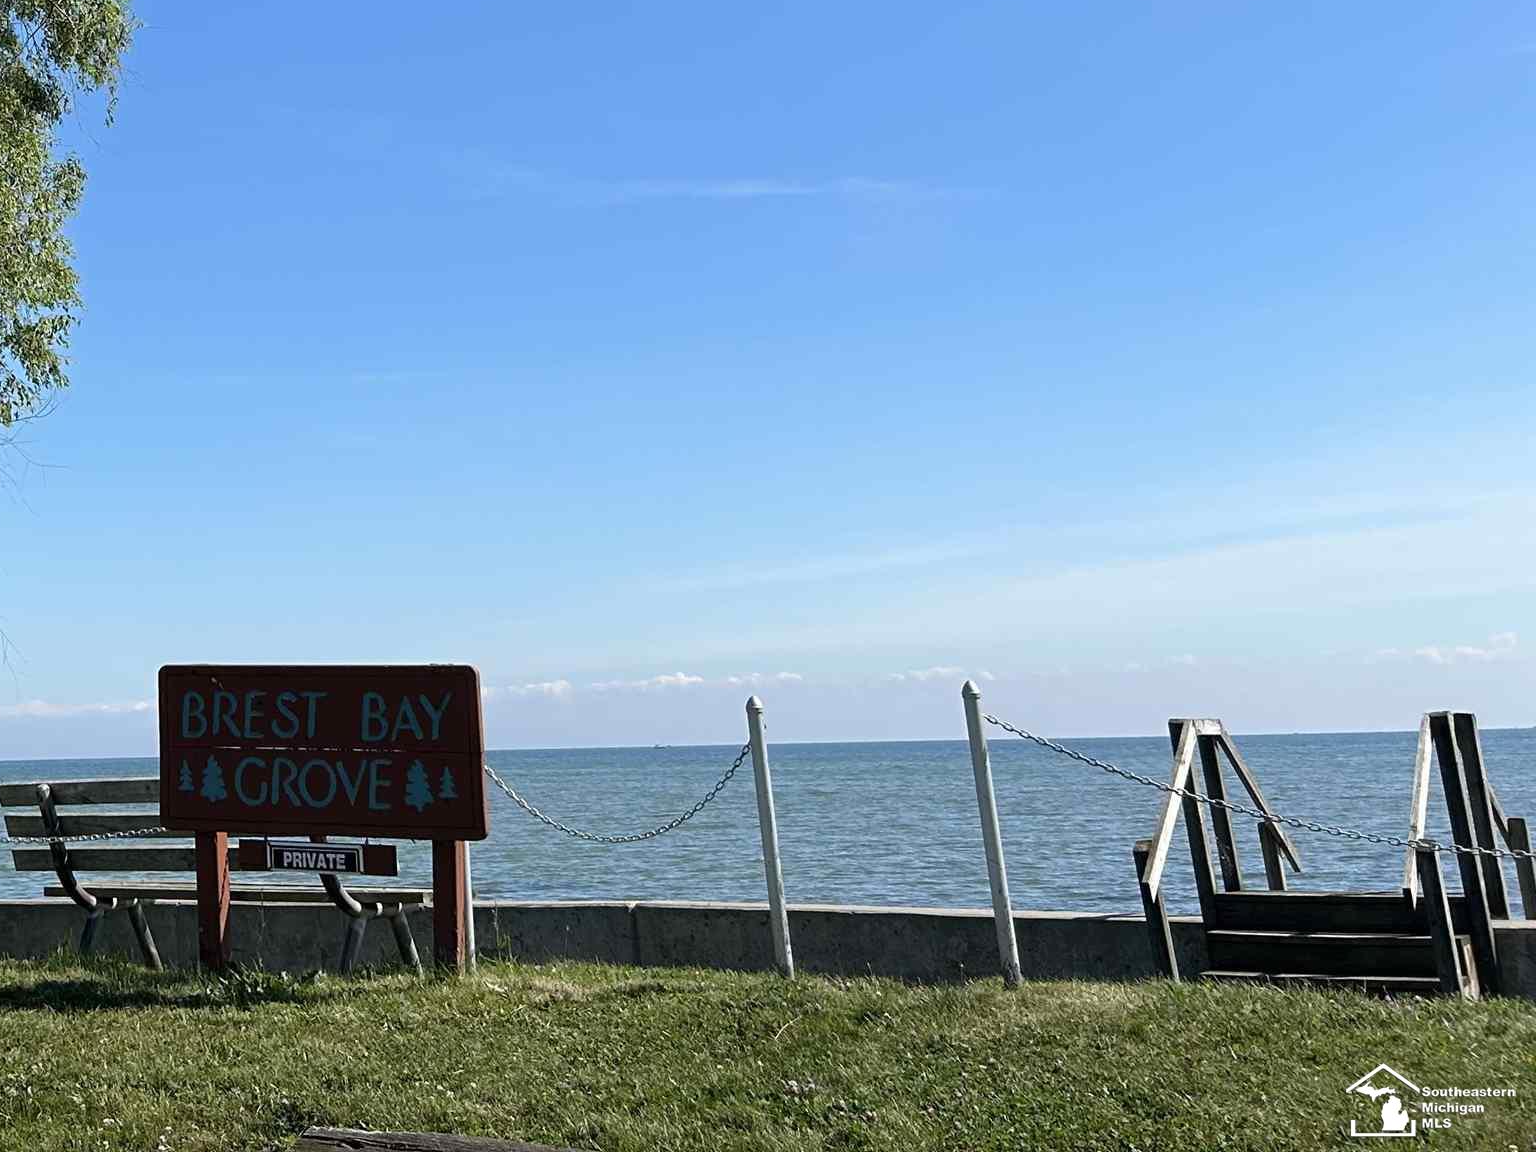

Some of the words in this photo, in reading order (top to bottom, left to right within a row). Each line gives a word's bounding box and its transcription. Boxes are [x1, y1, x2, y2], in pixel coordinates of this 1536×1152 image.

[179, 690, 328, 739] BREST
[360, 692, 452, 741] BAY
[234, 756, 393, 811] GROVE
[283, 851, 346, 870] PRIVATE
